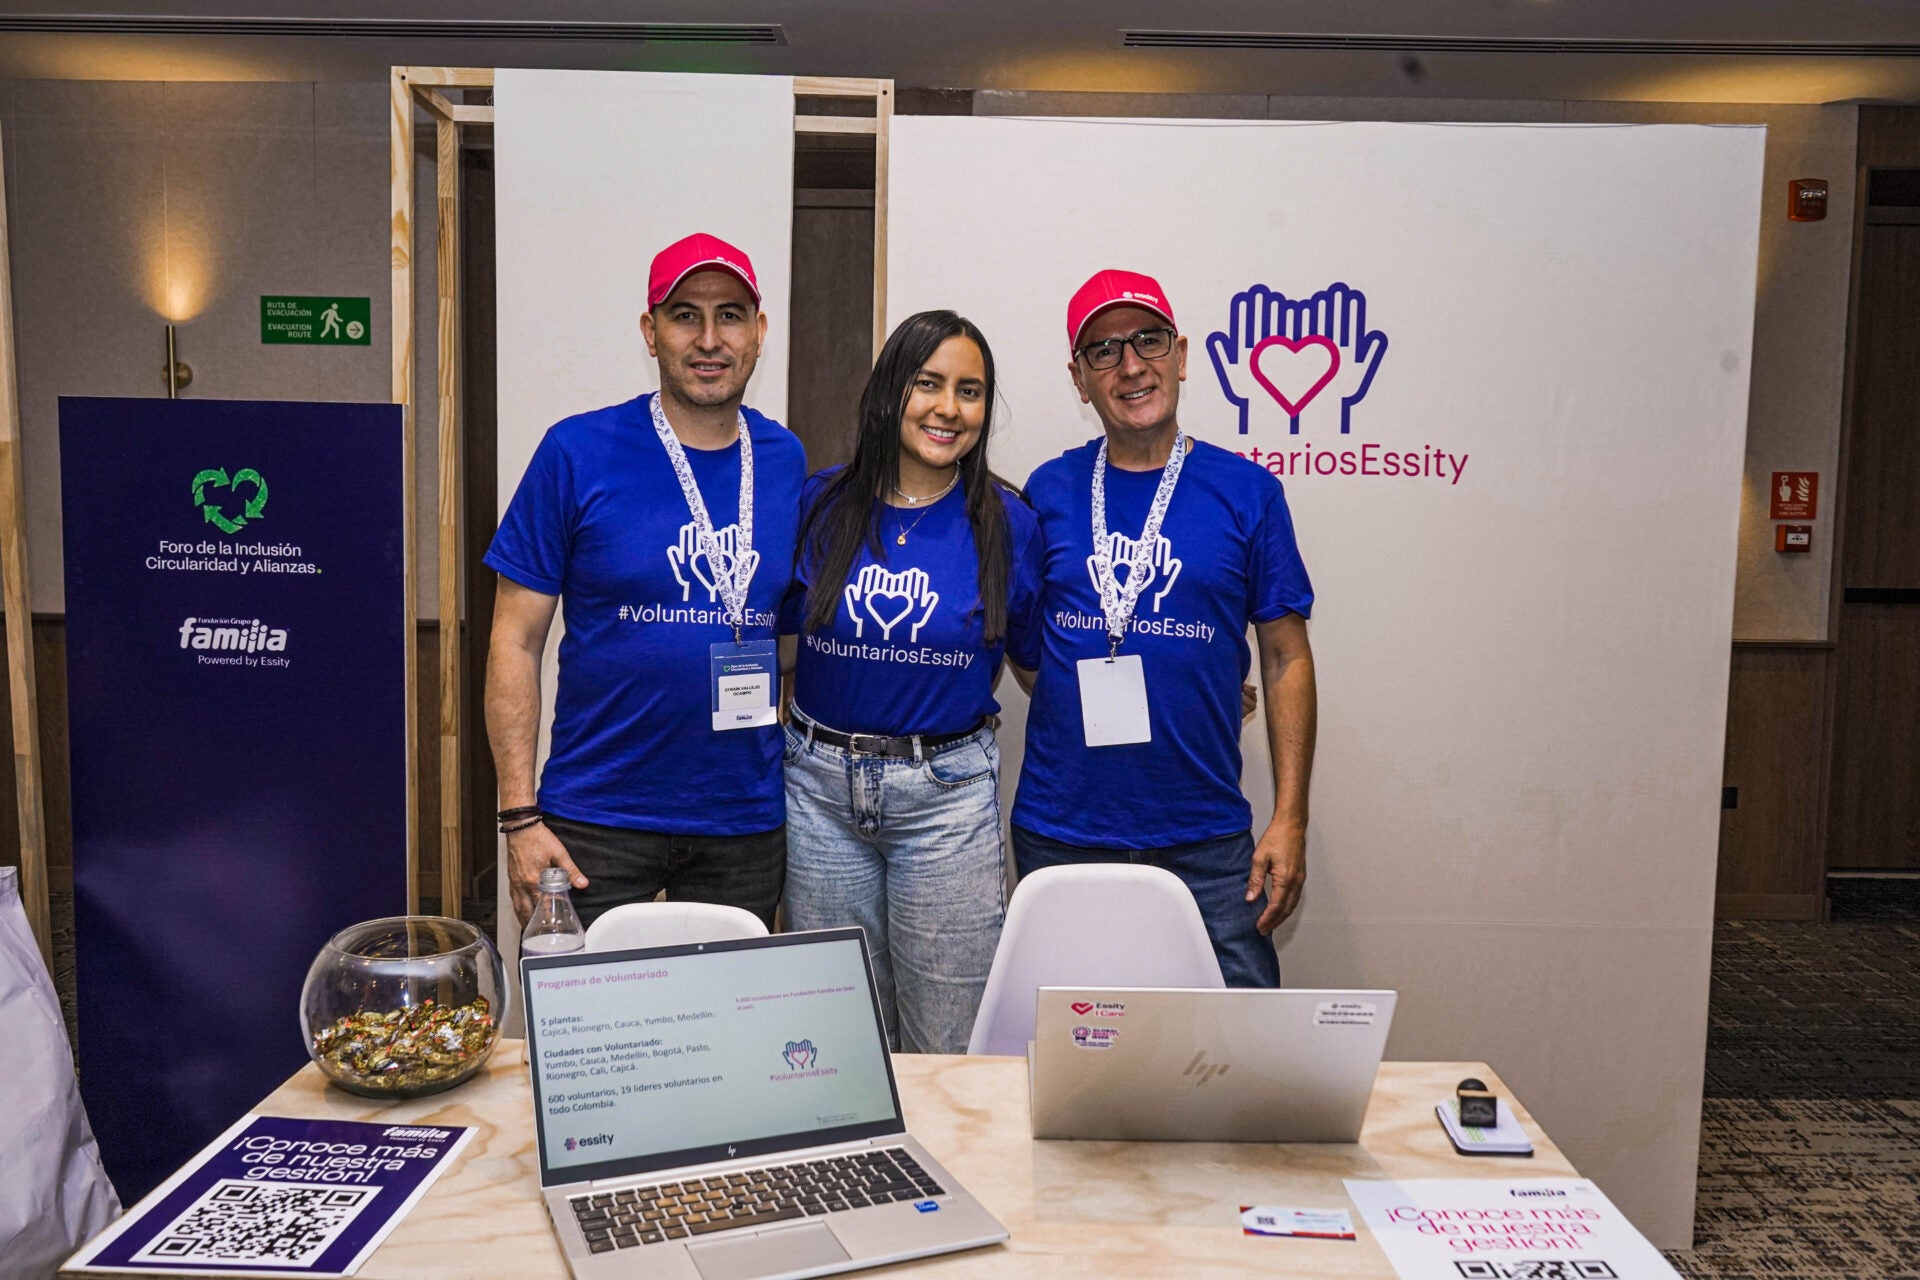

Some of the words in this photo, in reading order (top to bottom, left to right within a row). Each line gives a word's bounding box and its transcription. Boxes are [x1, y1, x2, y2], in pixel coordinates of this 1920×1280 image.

[267, 301, 286, 309] RUTA
[267, 309, 312, 317] EVACUACIÓN
[267, 323, 312, 331] EVACUATION
[287, 331, 312, 339] ROUTE
[1234, 442, 1469, 485] tariosEssity
[159, 540, 194, 554] Foro
[196, 540, 216, 555] de
[218, 541, 232, 555] la
[235, 541, 302, 557] Inclusión
[145, 556, 238, 572] Circularidad
[240, 561, 250, 575] y
[252, 559, 323, 575] Alianzas.
[197, 617, 230, 625] Fundación
[230, 618, 251, 626] Grupo
[179, 617, 288, 654] familia
[806, 634, 975, 670] #VoluntariosEssity
[198, 655, 243, 665] Powered
[245, 656, 258, 668] by
[261, 656, 290, 669] Essity
[537, 979, 587, 990] Programa
[589, 976, 602, 985] de
[604, 968, 669, 983] Voluntariado
[1096, 1002, 1125, 1010] Essity
[540, 1017, 547, 1026] 5
[549, 1014, 584, 1027] plantas:
[541, 1027, 570, 1038] Cajicá,
[572, 1023, 613, 1034] Rionegro,
[614, 1019, 643, 1029] Cauca,
[644, 1014, 675, 1026] Yumbo,
[543, 1047, 585, 1059] Ciudades
[586, 1045, 603, 1054] con
[604, 1038, 663, 1052] Voluntariado:
[544, 1060, 578, 1072] Yumbo,
[580, 1056, 608, 1066] Cauca,
[652, 1046, 684, 1058] Bogotá,
[686, 1043, 711, 1054] Pasto,
[546, 1069, 588, 1081] Rionegro,
[590, 1067, 608, 1076] Cali,
[610, 1063, 638, 1074] Cajicá.
[769, 1067, 838, 1082] #VoluntariosEssity
[548, 1094, 565, 1104] 600
[567, 1087, 619, 1101] voluntarios,
[621, 1086, 632, 1095] 19
[663, 1076, 710, 1088] voluntarios
[549, 1105, 570, 1115] todo
[572, 1099, 617, 1112] Colombia.
[233, 1136, 368, 1156] ¡Conoce
[370, 1143, 439, 1159] más
[579, 1133, 614, 1147] essity
[241, 1149, 286, 1164] de
[288, 1153, 405, 1171] nuestra
[243, 1166, 377, 1184] gestión!
[1384, 1205, 1525, 1223] ¡Conoce
[1530, 1204, 1602, 1221] más
[1417, 1219, 1461, 1236] de
[1467, 1221, 1592, 1236] nuestra
[1448, 1233, 1584, 1254] gestión!
